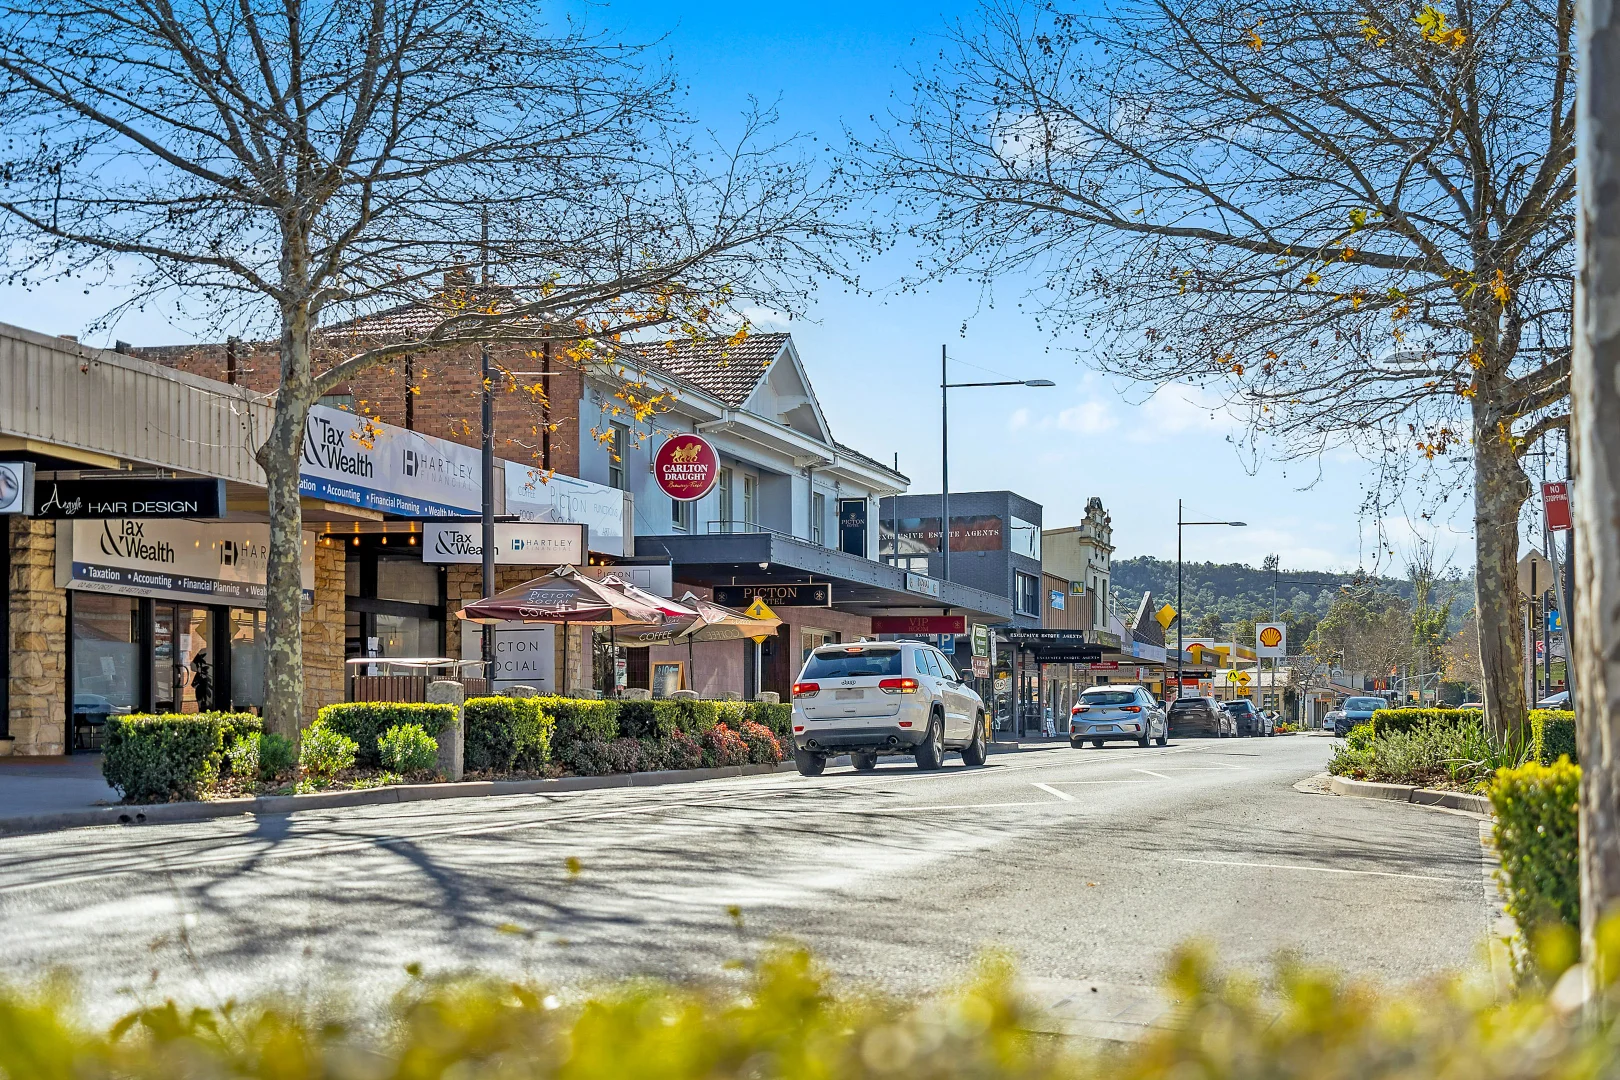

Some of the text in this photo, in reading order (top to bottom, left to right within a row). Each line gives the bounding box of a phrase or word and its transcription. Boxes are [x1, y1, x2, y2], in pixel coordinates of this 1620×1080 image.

[319, 418, 344, 447] Tax
[327, 445, 373, 478] Wealth
[421, 453, 472, 480] HARTLEY
[663, 464, 708, 473] CARLTON
[421, 470, 472, 491] FINANCIAL
[1550, 485, 1560, 494] NO
[299, 479, 316, 491] ation
[327, 484, 360, 502] Accounting
[370, 493, 396, 506] Financial
[396, 499, 420, 514] Planning
[1545, 494, 1567, 502] STOPPING
[88, 502, 127, 513] HAIR
[133, 501, 197, 513] DESIGN
[449, 531, 472, 543] Tax
[879, 529, 999, 541] EXCUSIVE ESTTE AGENTS
[526, 539, 573, 547] HARTLEY
[125, 536, 175, 564] Wealth
[88, 566, 120, 580] Taxation
[132, 572, 172, 588] Accounting
[183, 578, 212, 591] Financial
[213, 583, 240, 595] Planning
[530, 590, 574, 599] PICTON
[744, 587, 798, 599] PICTON
[909, 617, 929, 626] VIP
[639, 630, 673, 641] COFFEE
[942, 633, 951, 646] P
[497, 641, 538, 652] CTON
